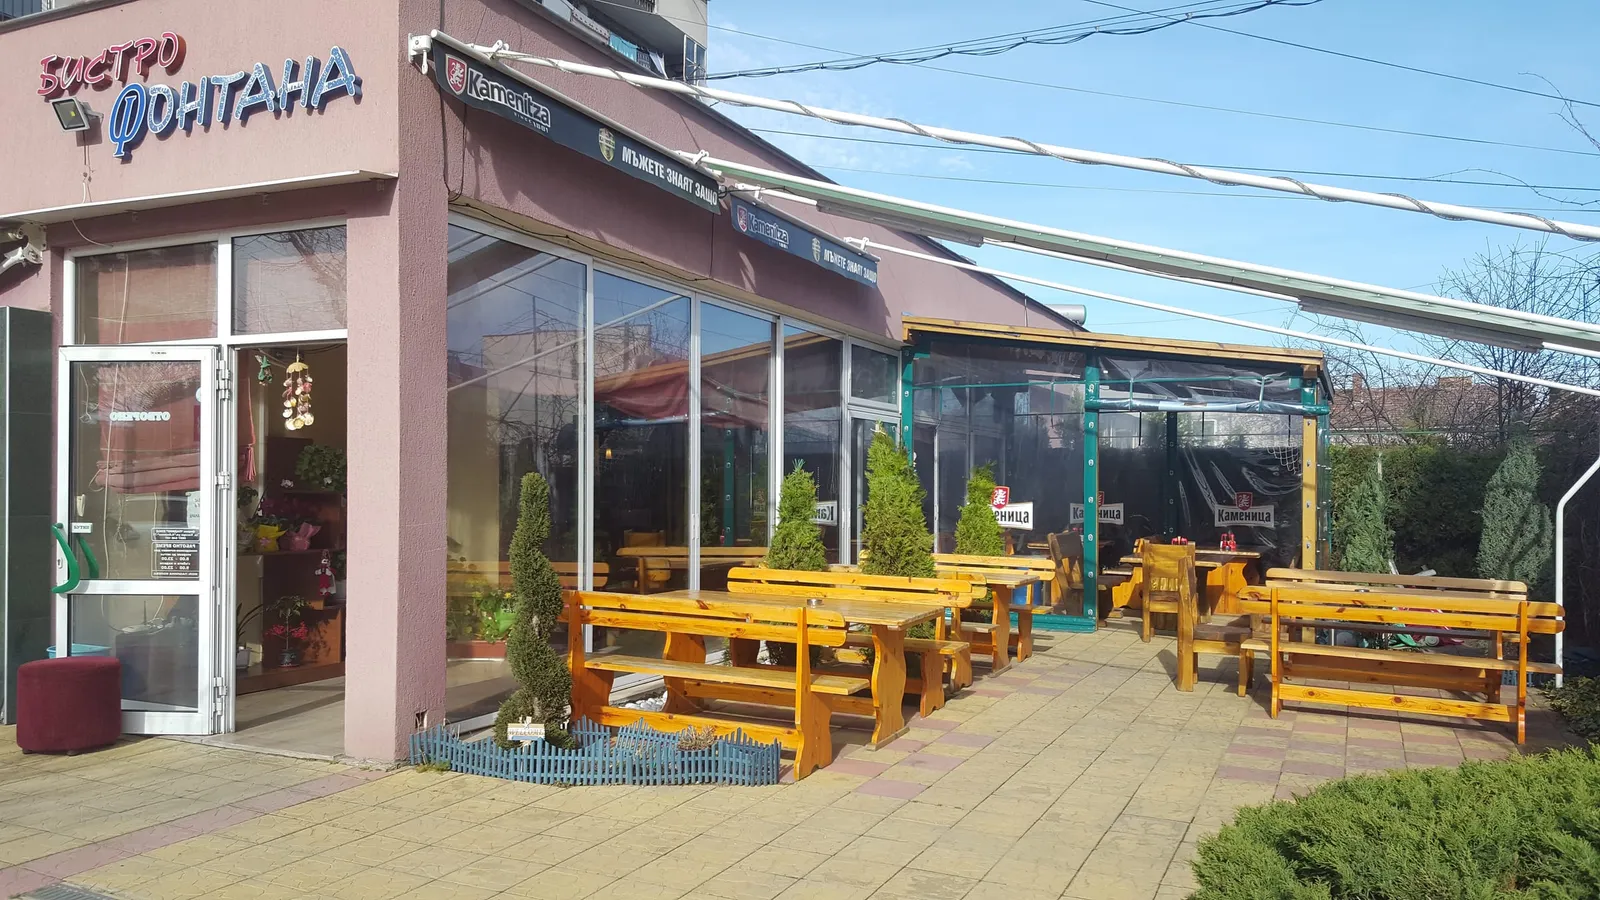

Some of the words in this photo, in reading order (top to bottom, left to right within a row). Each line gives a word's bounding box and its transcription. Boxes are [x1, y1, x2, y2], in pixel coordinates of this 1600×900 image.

[37, 31, 183, 97] БИСТРО
[109, 46, 359, 159] ФОНТАНА
[467, 67, 551, 128] Kamenitza
[622, 146, 665, 179] МЪЖЕТЕ
[666, 168, 694, 194] ЗНАЯТ
[695, 182, 718, 206] ЗАЩО
[748, 212, 789, 245] Kamenitza
[823, 248, 846, 270] МЪЖЕТЕ
[846, 261, 863, 276] ЗНАЯТ
[863, 266, 877, 283] ЗАЩО
[994, 510, 1030, 525] еница
[1217, 509, 1271, 523] Каменица
